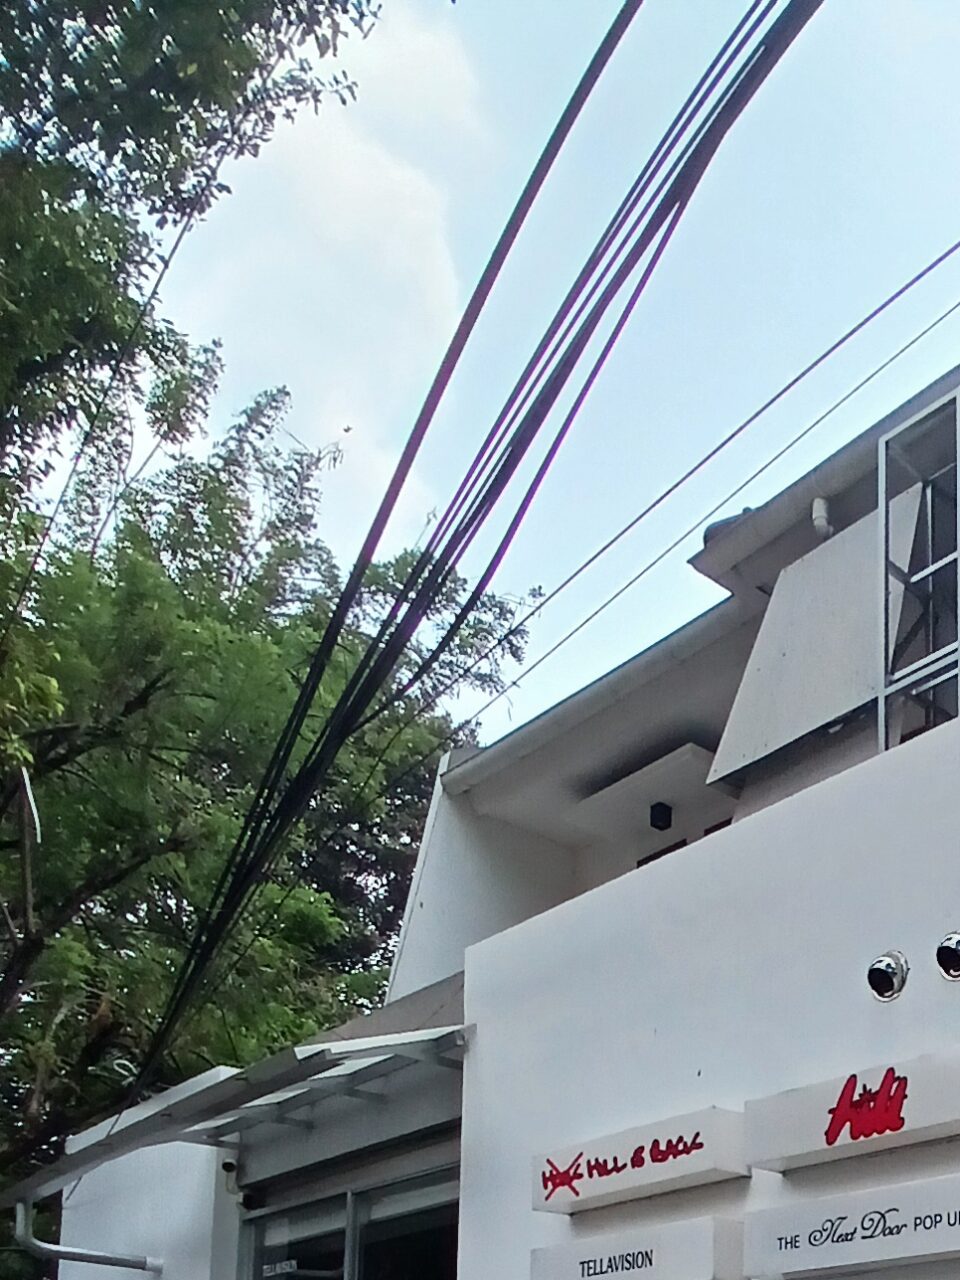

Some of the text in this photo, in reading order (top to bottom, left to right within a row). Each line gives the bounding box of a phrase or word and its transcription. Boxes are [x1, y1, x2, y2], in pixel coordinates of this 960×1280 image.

[777, 1234, 801, 1251] THE
[808, 1215, 858, 1247] Next
[861, 1207, 908, 1240] Door
[914, 1213, 943, 1232] POP
[579, 1249, 653, 1278] TELLAVISION
